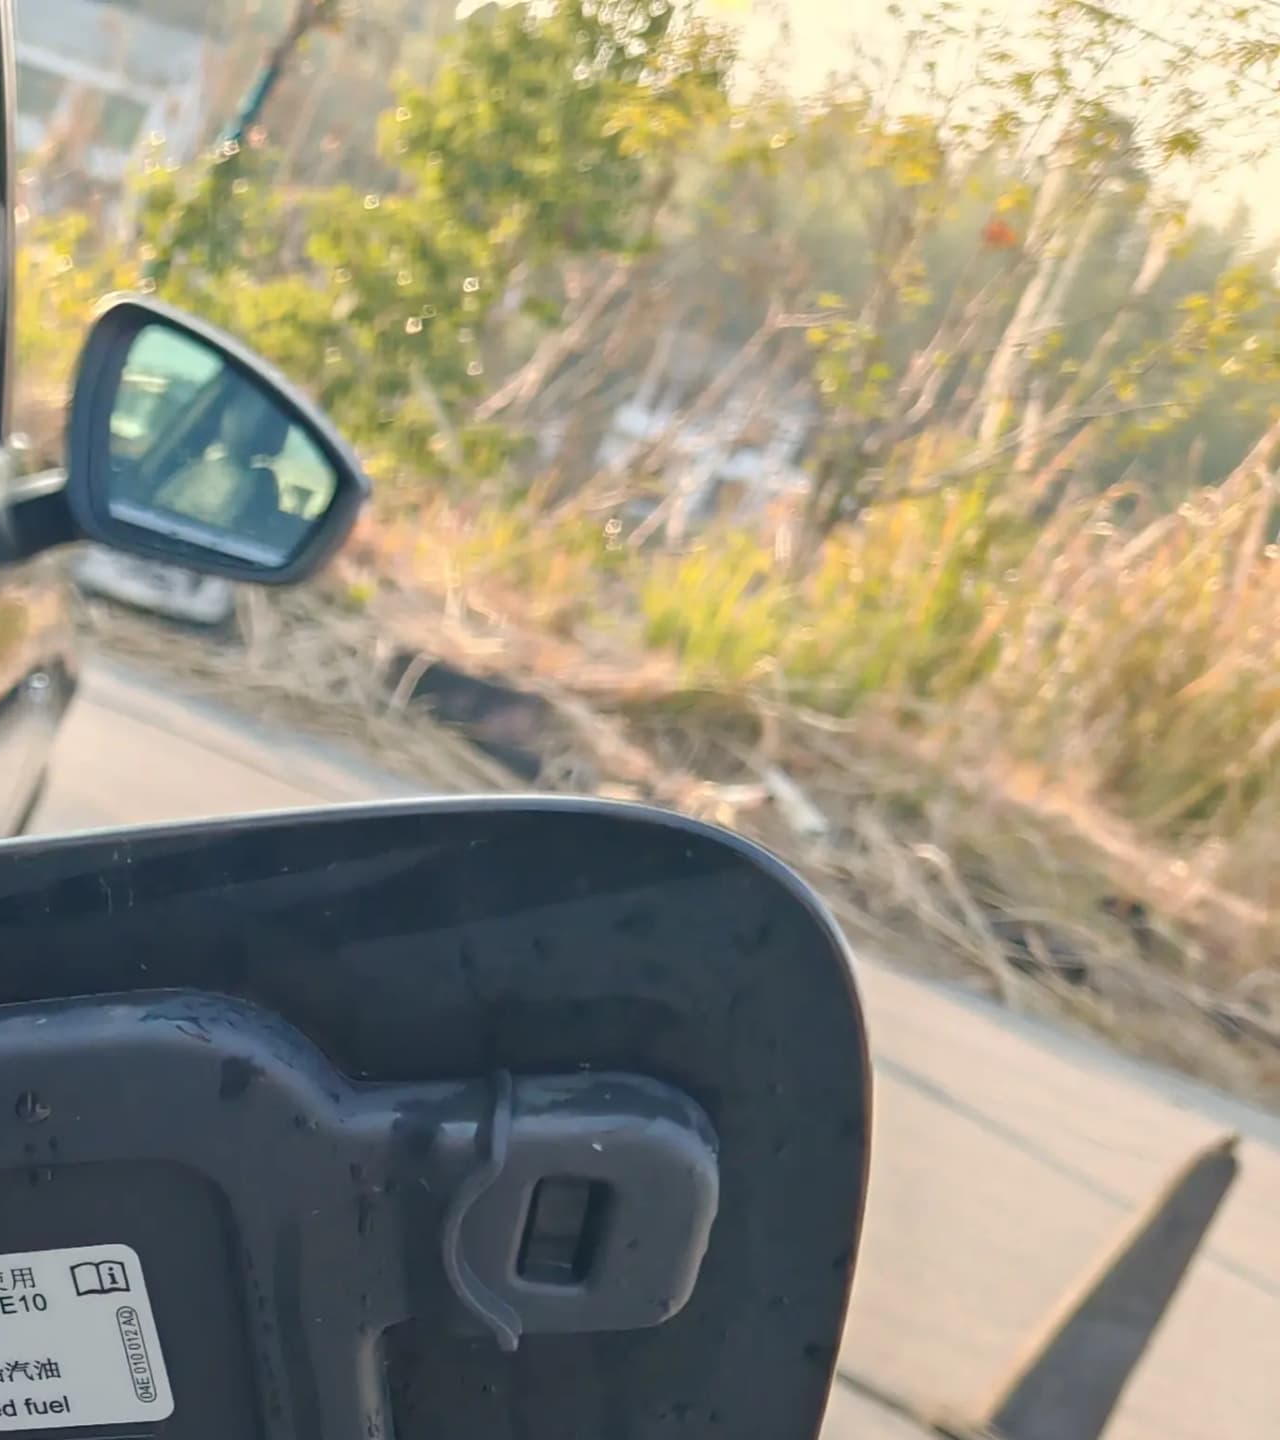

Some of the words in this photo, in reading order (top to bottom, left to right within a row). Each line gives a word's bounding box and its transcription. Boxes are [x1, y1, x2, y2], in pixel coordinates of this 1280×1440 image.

[0, 1293, 48, 1313] E10
[125, 1329, 141, 1350] 012
[131, 1353, 147, 1374] 010
[136, 1377, 153, 1399] 04E
[24, 1396, 71, 1416] fuel
